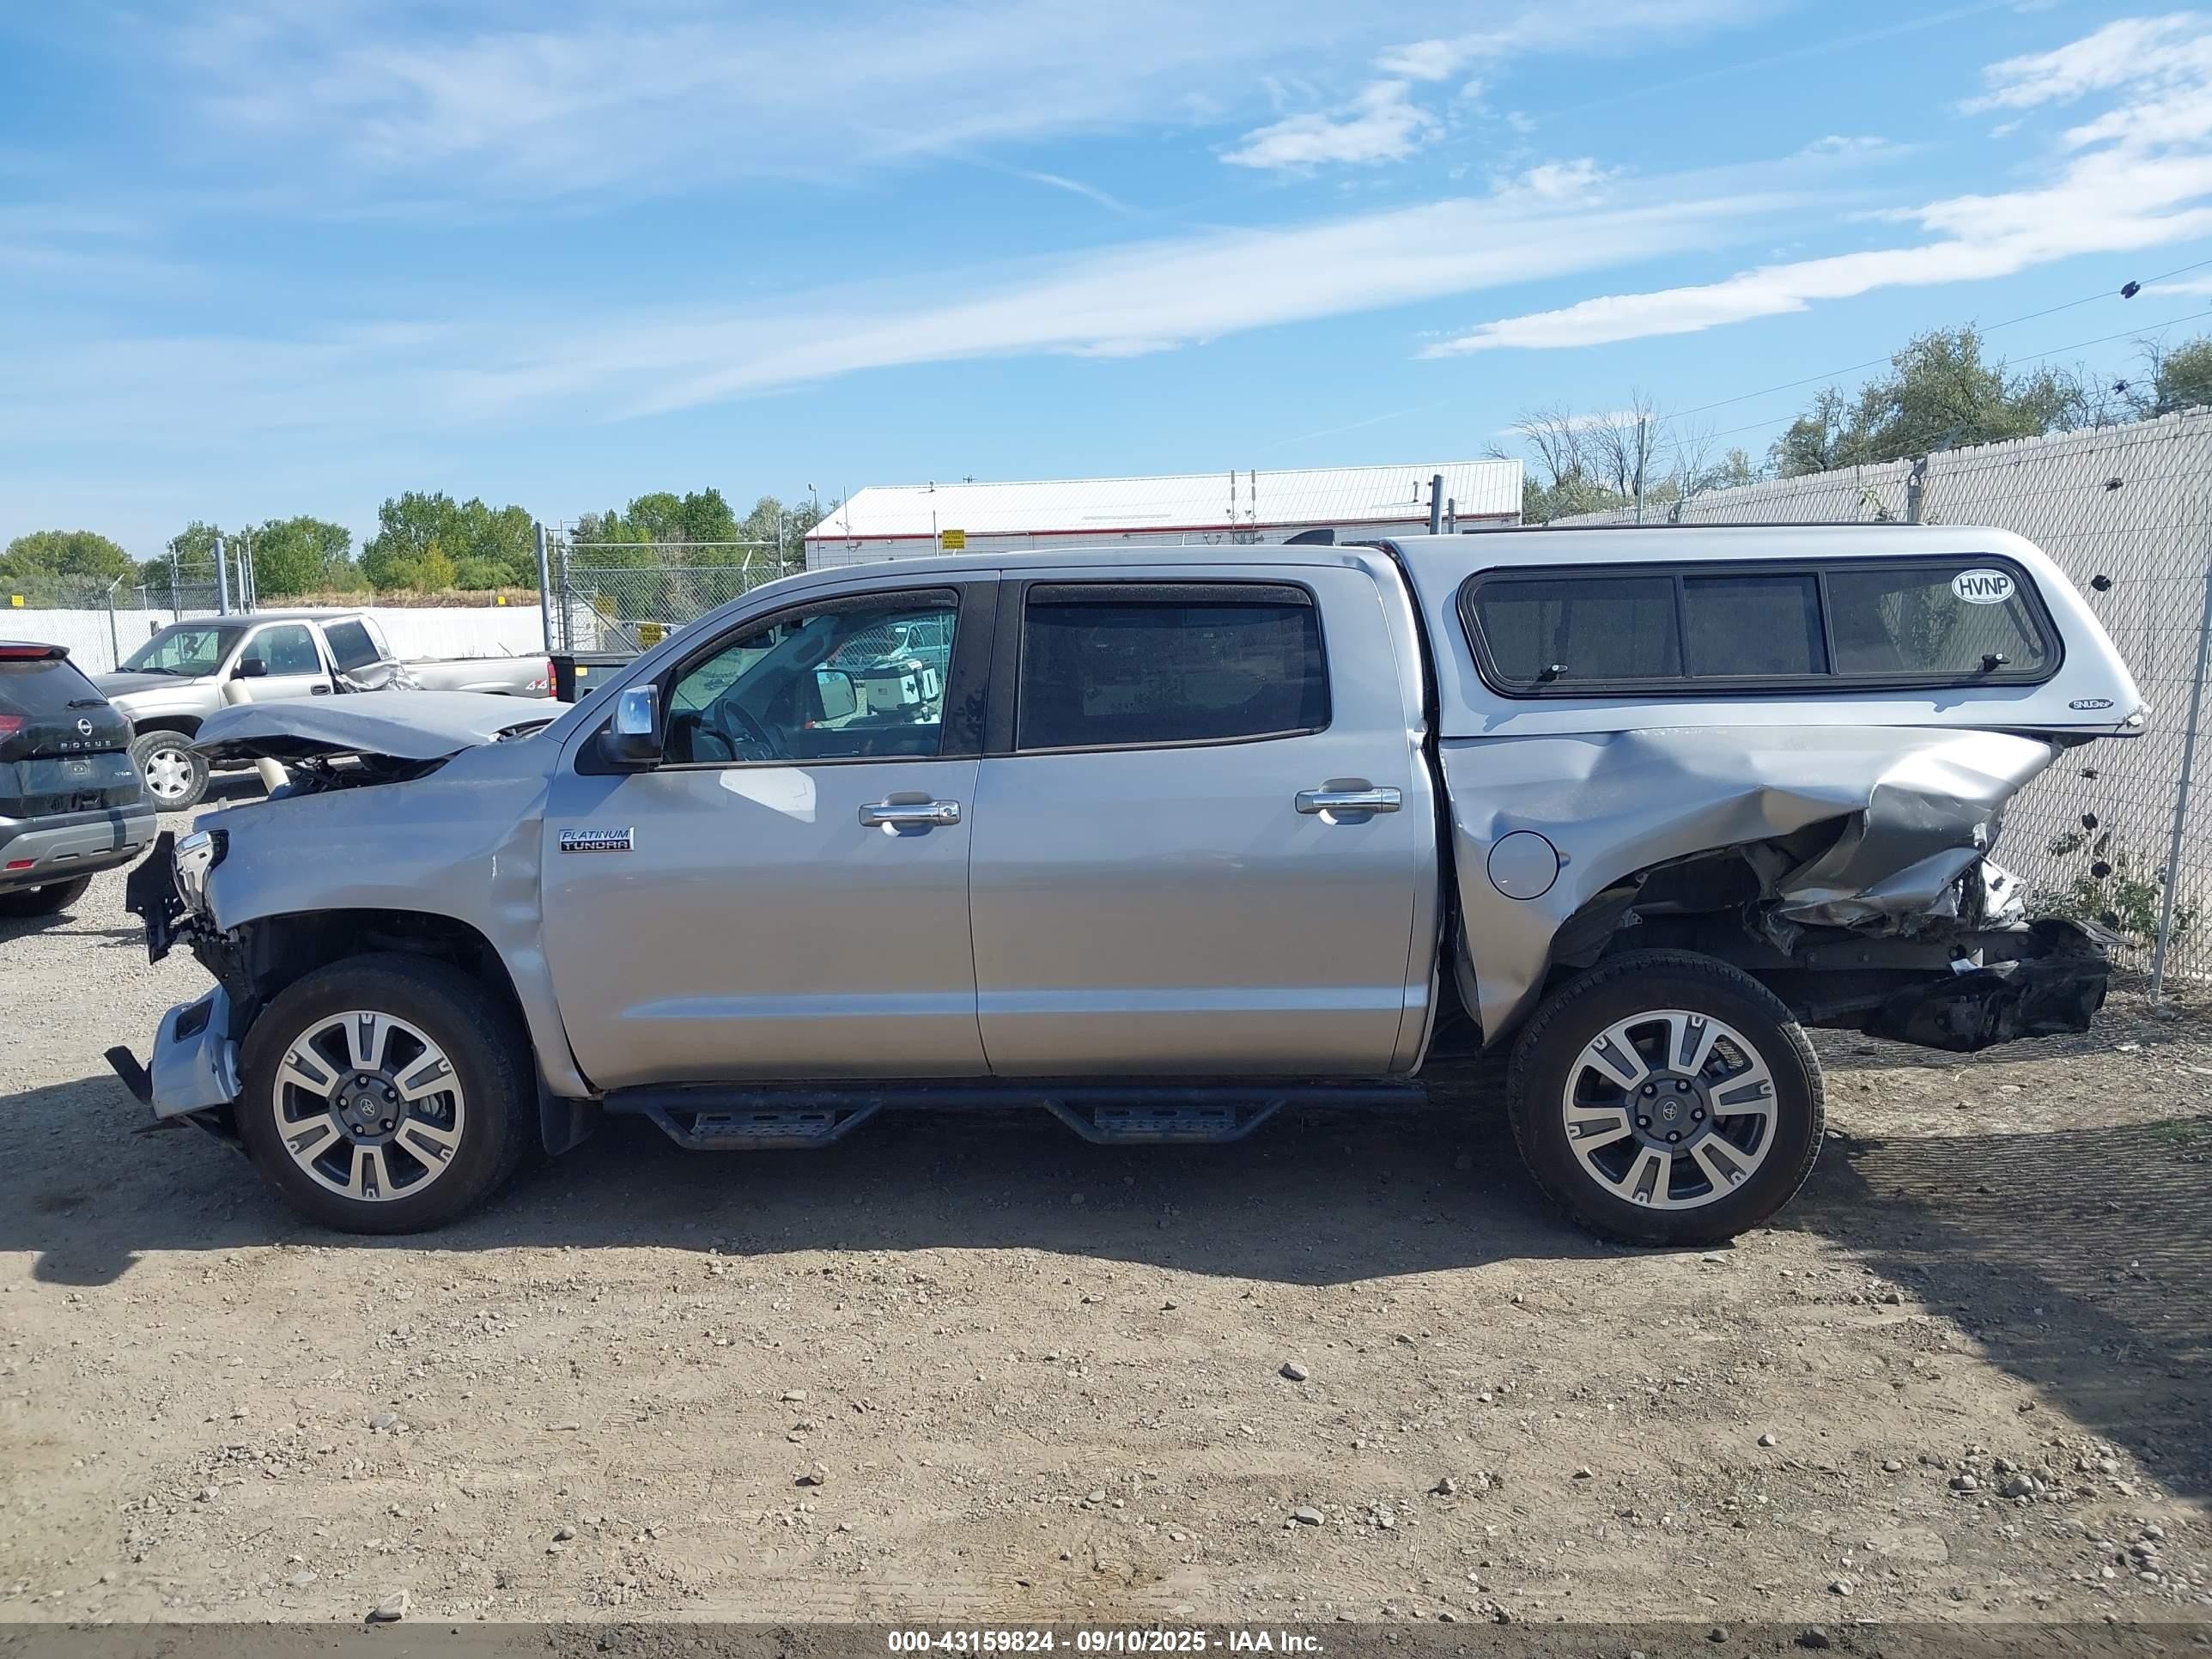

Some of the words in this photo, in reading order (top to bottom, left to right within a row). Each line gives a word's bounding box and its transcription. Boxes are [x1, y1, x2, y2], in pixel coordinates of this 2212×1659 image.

[1959, 576, 2009, 596] HVNP
[60, 740, 112, 749] ROGUE
[562, 830, 629, 840] PLATINUM
[562, 841, 629, 850] TUNDRA
